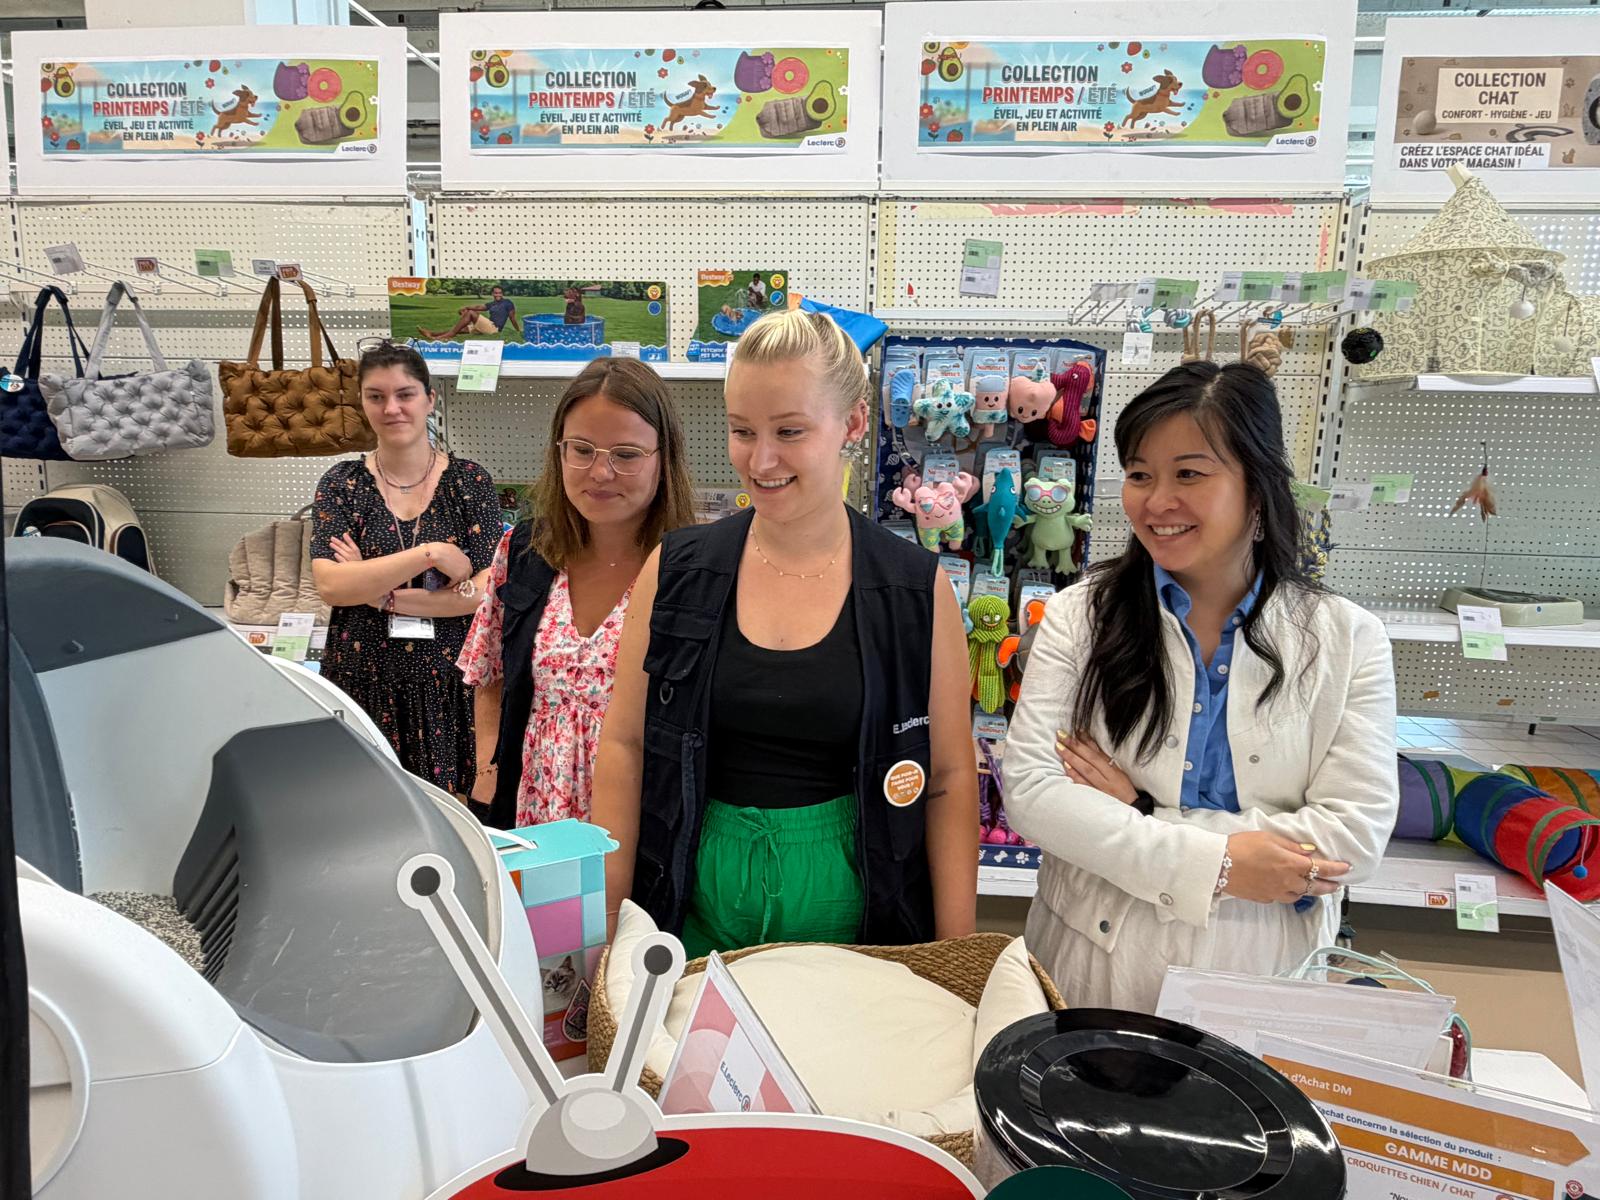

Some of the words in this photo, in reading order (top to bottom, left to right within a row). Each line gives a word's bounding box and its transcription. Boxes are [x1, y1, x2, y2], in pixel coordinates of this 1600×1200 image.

[545, 71, 636, 88] COLLECTION
[1001, 65, 1098, 82] COLLECTION
[1454, 72, 1546, 87] COLLECTION
[107, 82, 187, 97] COLLECTION
[982, 87, 1074, 104] PRINTEMPS
[1087, 83, 1117, 104] ÉTÉ
[528, 92, 615, 108] PRINTEMPS
[628, 88, 656, 108] ÉTÉ
[1478, 91, 1520, 105] CHAT
[93, 101, 169, 116] PRINTEMPS
[180, 97, 205, 116] ÉTÉ
[994, 106, 1023, 120] ÉVEIL,
[1025, 109, 1043, 119] JEU
[1046, 109, 1057, 119] ET
[1060, 106, 1102, 119] ACTIVITÉ
[1442, 110, 1482, 119] CONFORT
[1490, 109, 1528, 119] HYGIÈNE
[1534, 110, 1552, 119] JEU
[540, 111, 568, 124] ÉVEIL,
[570, 113, 587, 122] JEU
[589, 113, 600, 122] ET
[602, 110, 642, 122] ACTIVITÉ
[104, 119, 128, 131] ÉVEIL,
[129, 121, 144, 130] JEU
[147, 121, 156, 129] ET
[158, 119, 194, 129] ACTIVITÉ
[562, 125, 573, 134] EN
[576, 125, 602, 134] PLEIN
[604, 125, 619, 134] AIR
[1016, 121, 1029, 131] EN
[1031, 121, 1058, 131] PLEIN
[1060, 121, 1077, 131] AIR
[123, 132, 134, 140] EN
[136, 132, 159, 140] PLEIN
[161, 132, 174, 140] AIR
[1400, 144, 1433, 156] CRÉEZ
[1435, 146, 1483, 156] L'ESPACE
[1484, 146, 1512, 156] CHAT
[1514, 144, 1545, 156] IDÉAL
[1399, 158, 1428, 168] DANS
[1466, 158, 1515, 168] MAGASIN
[720, 1061, 743, 1102] E.Leclerc
[1291, 1073, 1330, 1090] d'Achat
[1333, 1083, 1352, 1096] DM
[1346, 1114, 1387, 1132] concerne
[1389, 1125, 1398, 1134] la
[1400, 1129, 1441, 1146] sélection
[1444, 1141, 1456, 1151] du
[1458, 1145, 1493, 1160] produit
[1385, 1142, 1449, 1169] GAMME
[1452, 1159, 1492, 1180] MDD
[1346, 1157, 1408, 1180] CROQUETTES
[1409, 1174, 1440, 1189] CHIEN
[1449, 1186, 1476, 1199] CHAT
